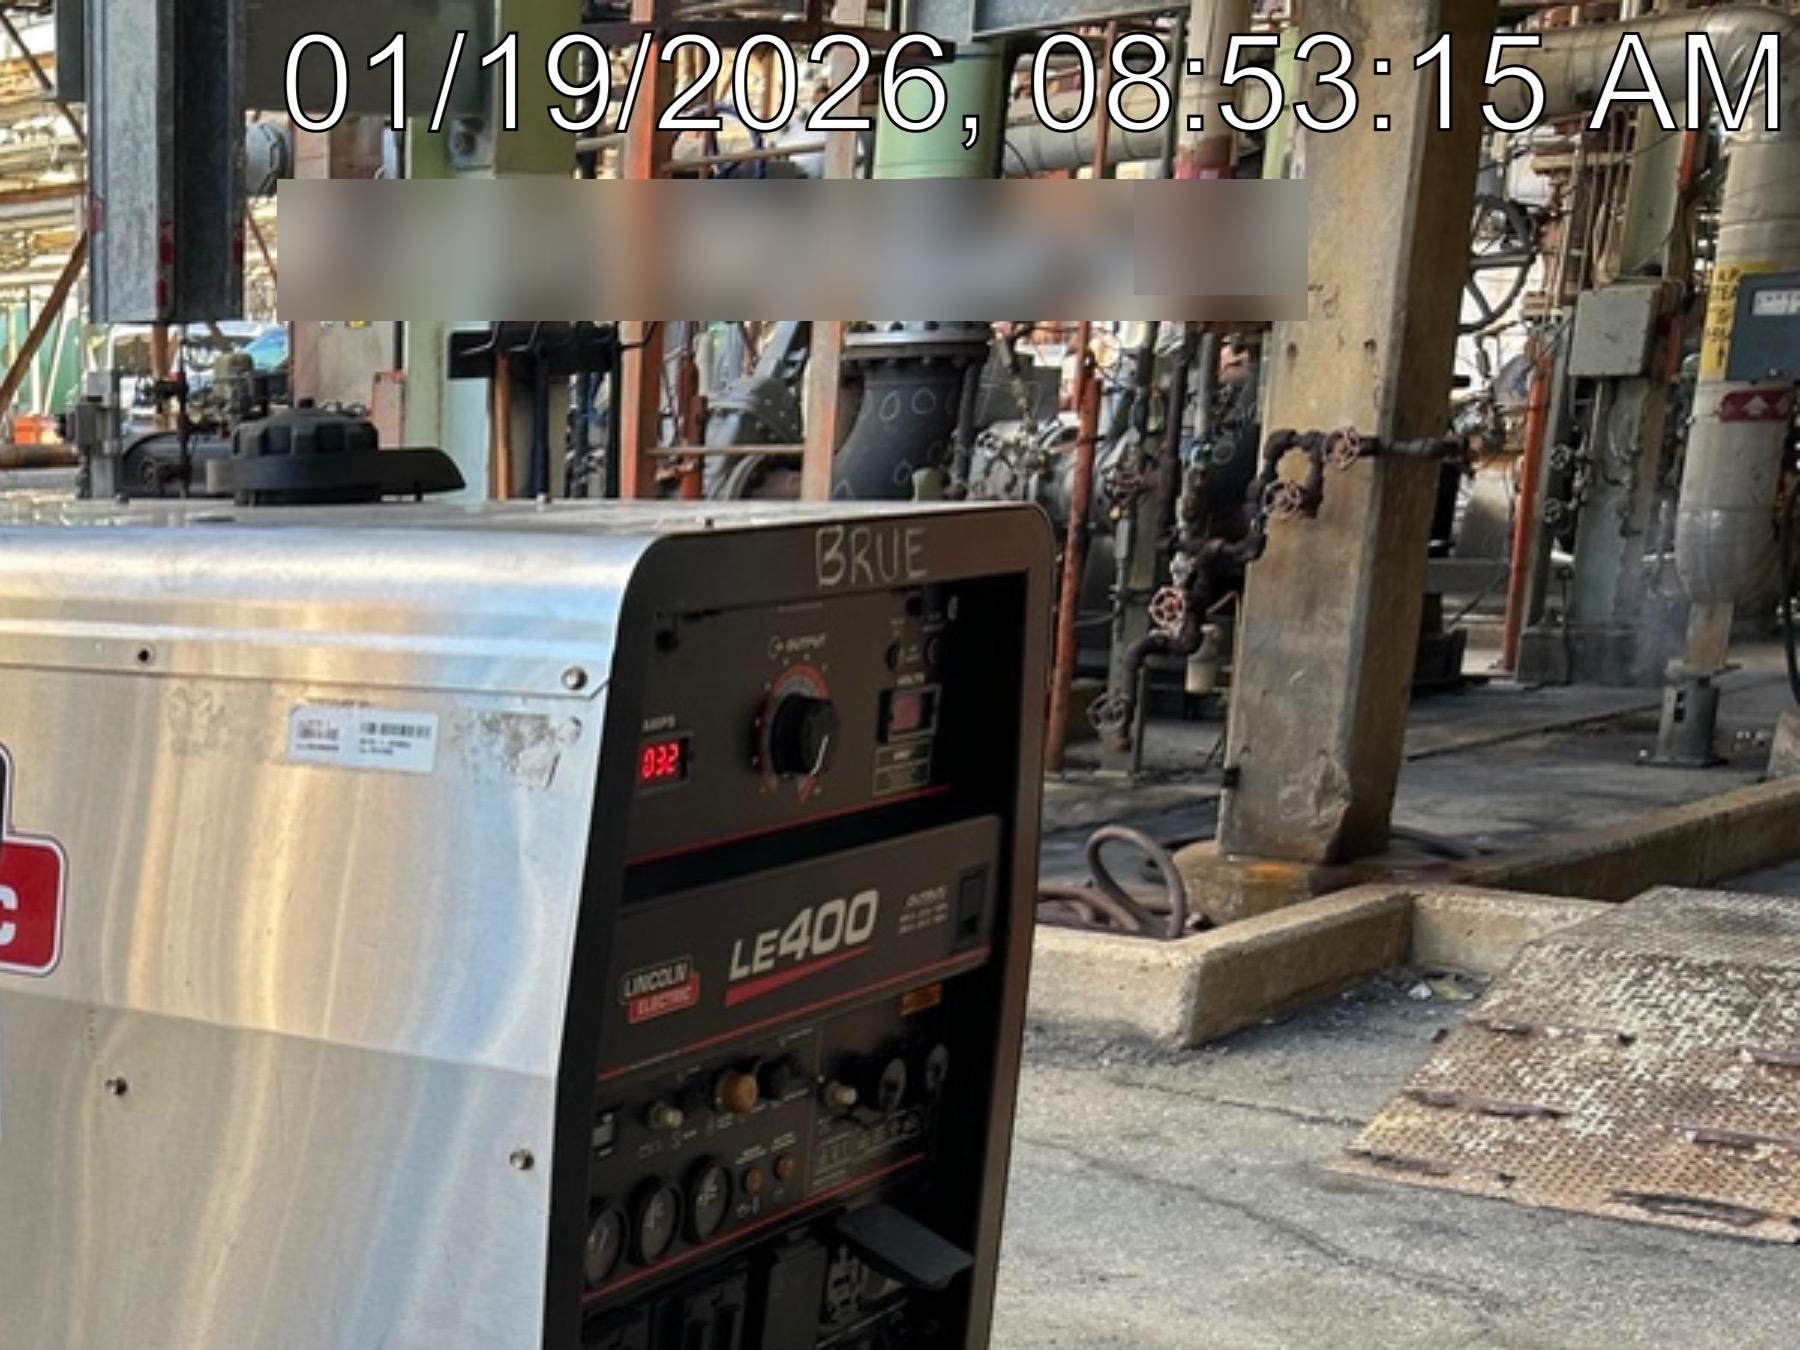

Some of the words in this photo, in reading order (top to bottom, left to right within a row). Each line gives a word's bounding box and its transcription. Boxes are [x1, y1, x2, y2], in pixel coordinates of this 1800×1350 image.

[814, 525, 928, 587] BRUE
[641, 743, 679, 779] 032
[728, 888, 880, 982] LE400
[622, 961, 689, 998] LINCOLN
